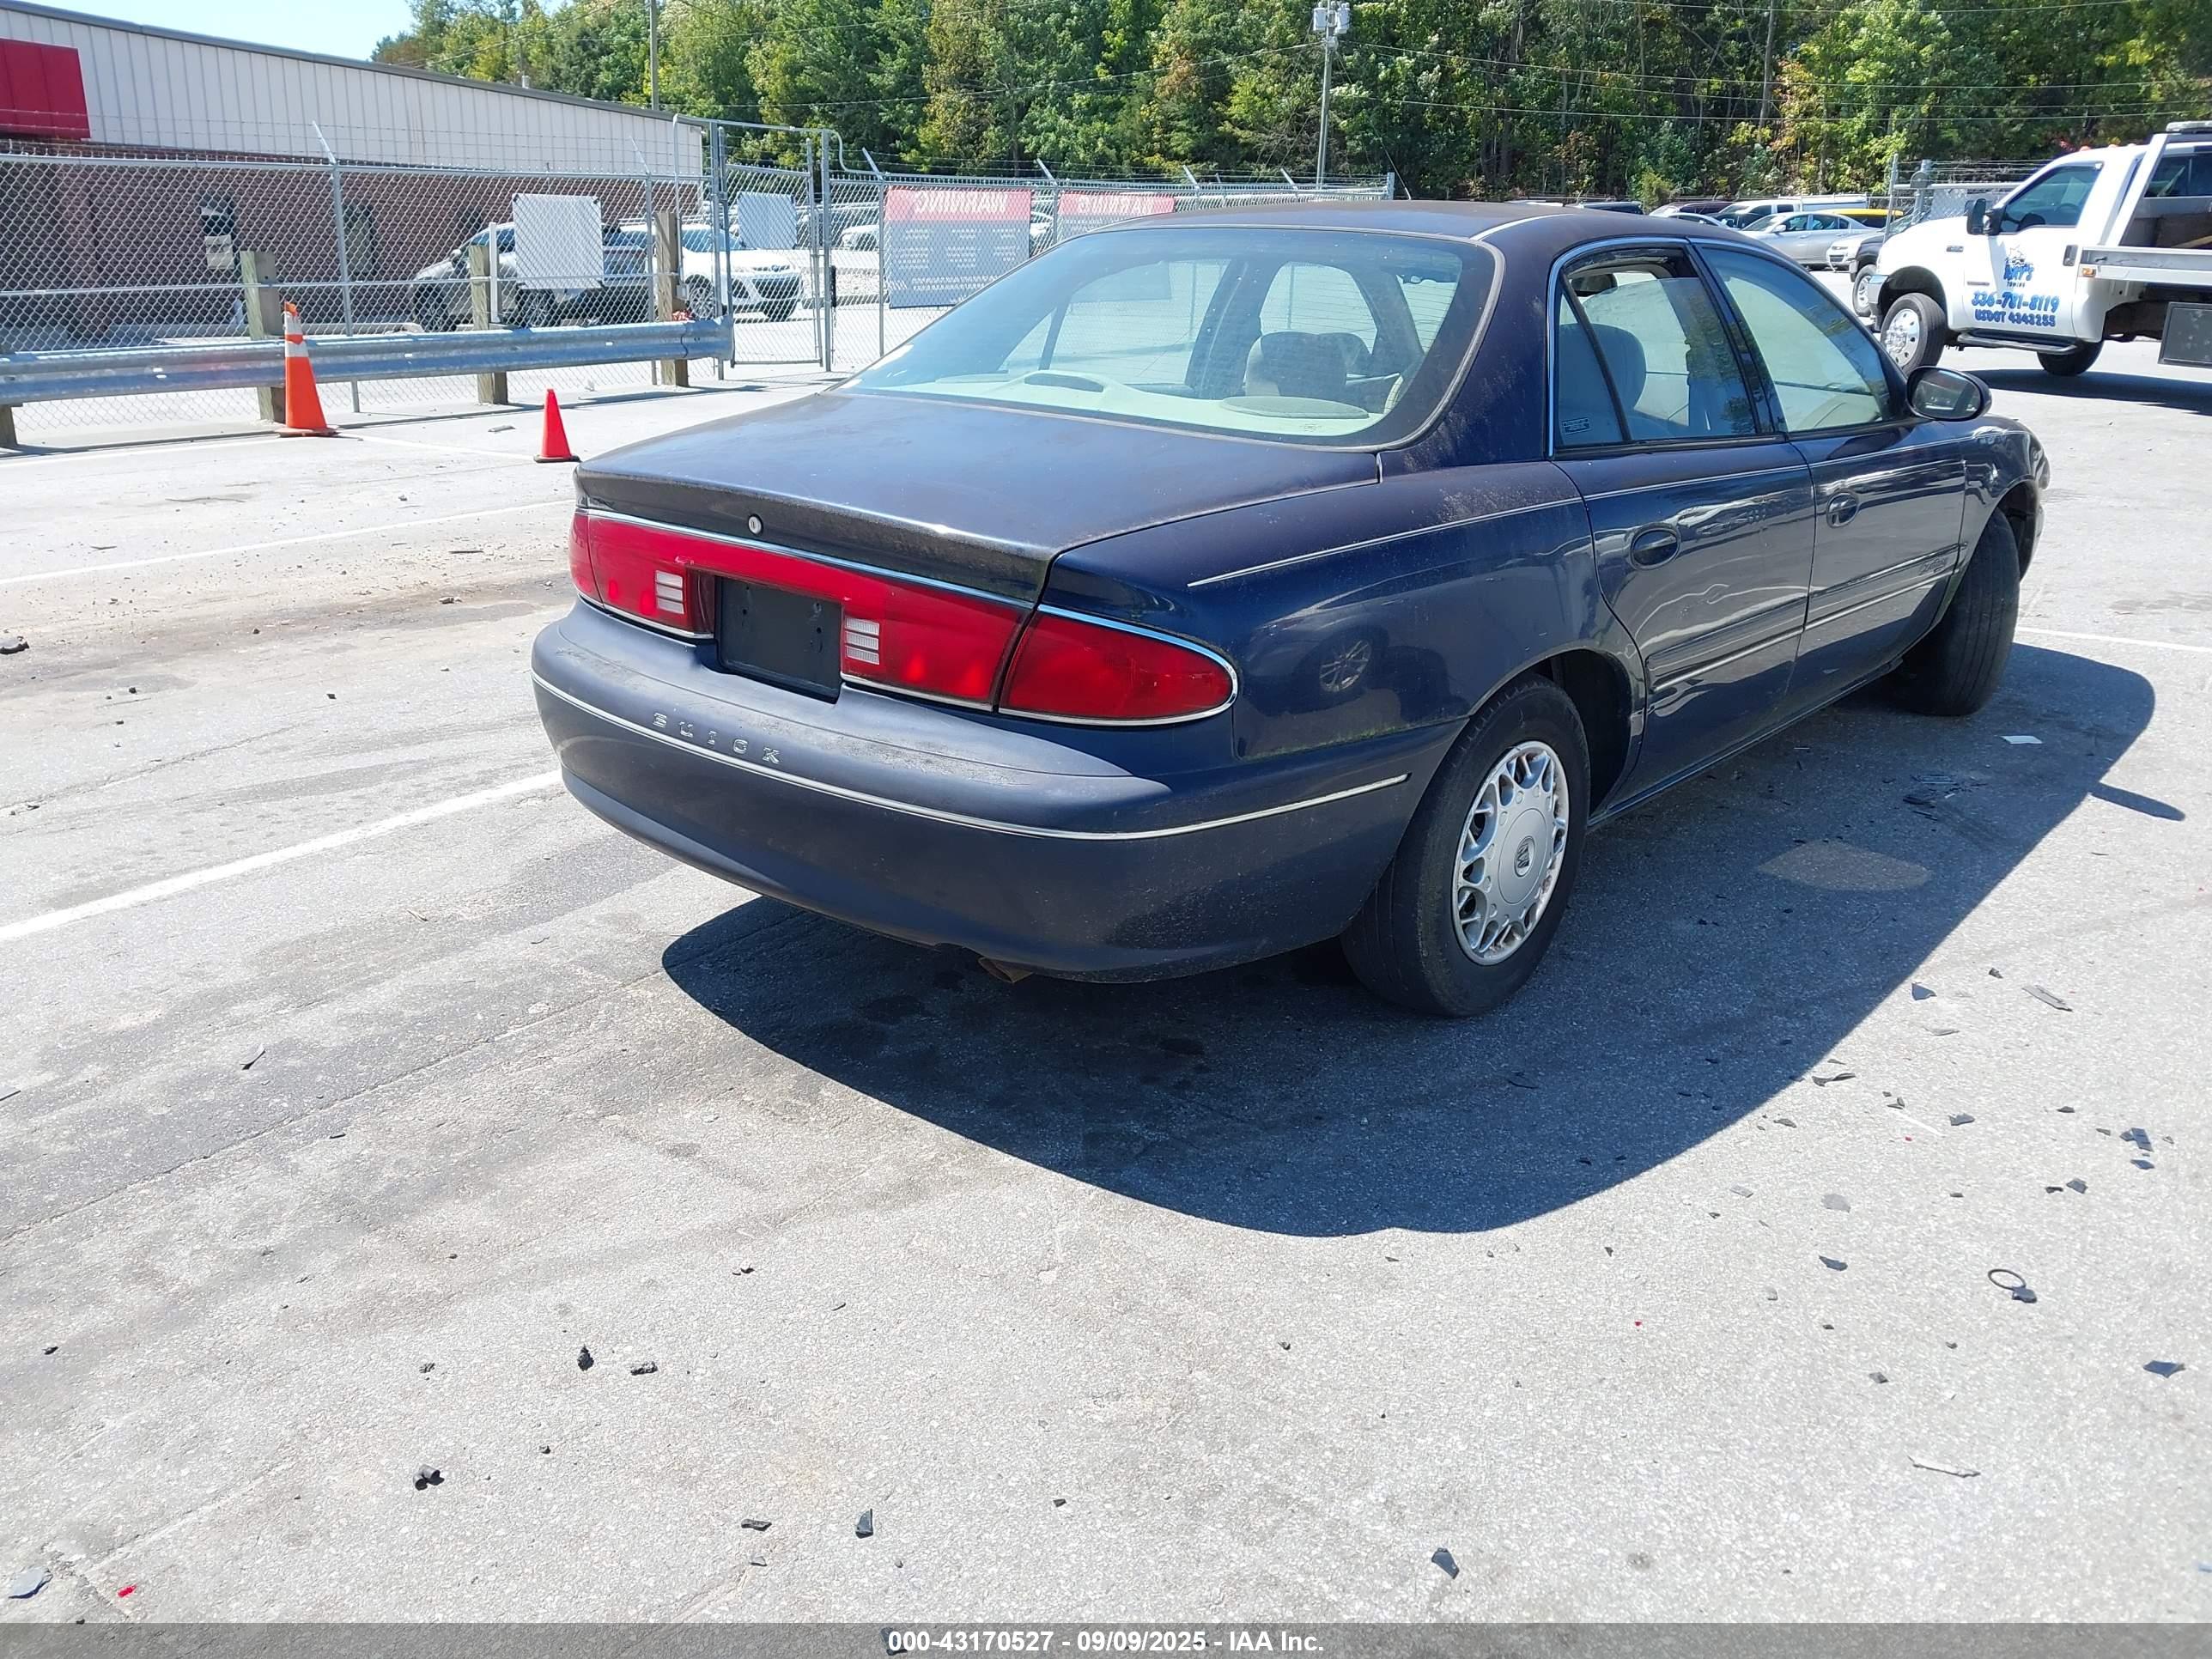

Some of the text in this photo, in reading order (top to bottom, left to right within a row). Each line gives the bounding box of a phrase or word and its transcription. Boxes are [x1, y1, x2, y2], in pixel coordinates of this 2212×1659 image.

[1972, 291, 2060, 313] 336-781-8119
[1975, 309, 2006, 323] USDOT
[653, 712, 781, 764] BUICK
